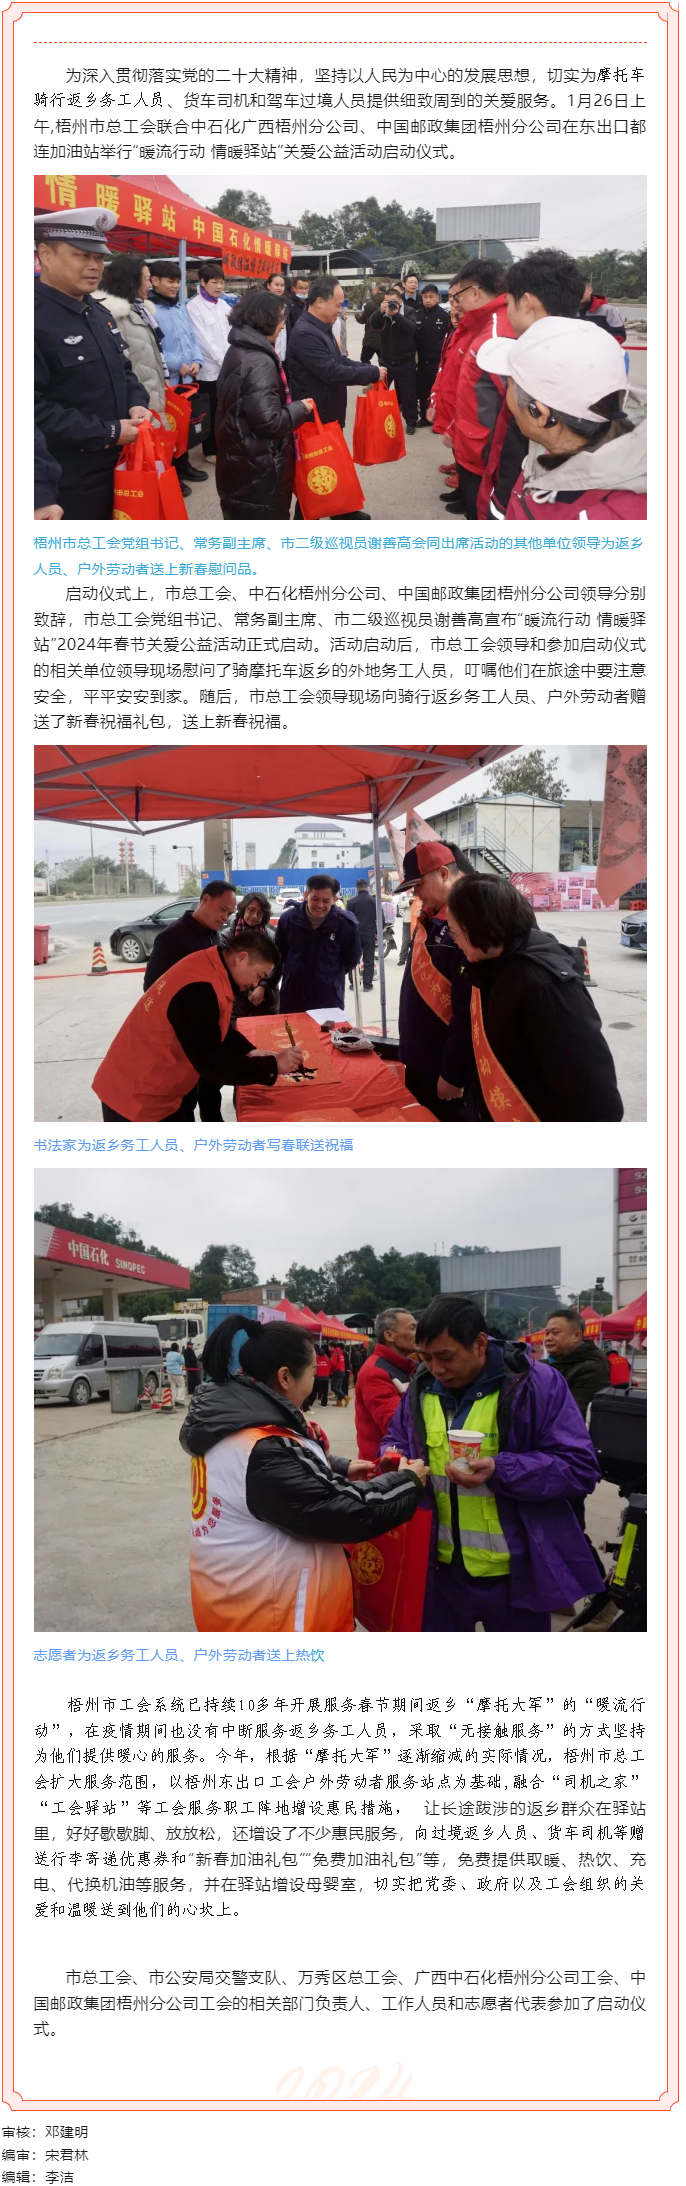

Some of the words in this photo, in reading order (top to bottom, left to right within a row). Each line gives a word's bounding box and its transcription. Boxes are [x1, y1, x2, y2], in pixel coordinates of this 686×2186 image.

[193, 216, 288, 260] 中国石化情暖驿站
[34, 562, 257, 576] 人员、户外劳动者送上新春慰问品。
[34, 713, 287, 729] 送了新春祝福礼包，送上新春祝福。
[34, 1138, 353, 1152] 书法家为返乡务工人员、户外劳动者写春联送祝福
[68, 1239, 109, 1266] 中国石化
[115, 1258, 146, 1275] SINOPEC
[34, 1648, 324, 1662] 志愿者为返乡务工人员、户外劳动者送上热饮
[35, 1902, 238, 1917] 爱和温暖送到他们的心坎上。
[34, 2021, 55, 2036] 式。
[2, 2126, 88, 2139] 审核：邓建明
[2, 2149, 88, 2161] 编审：宋君林
[2, 2170, 74, 2184] 编辑：李洁
